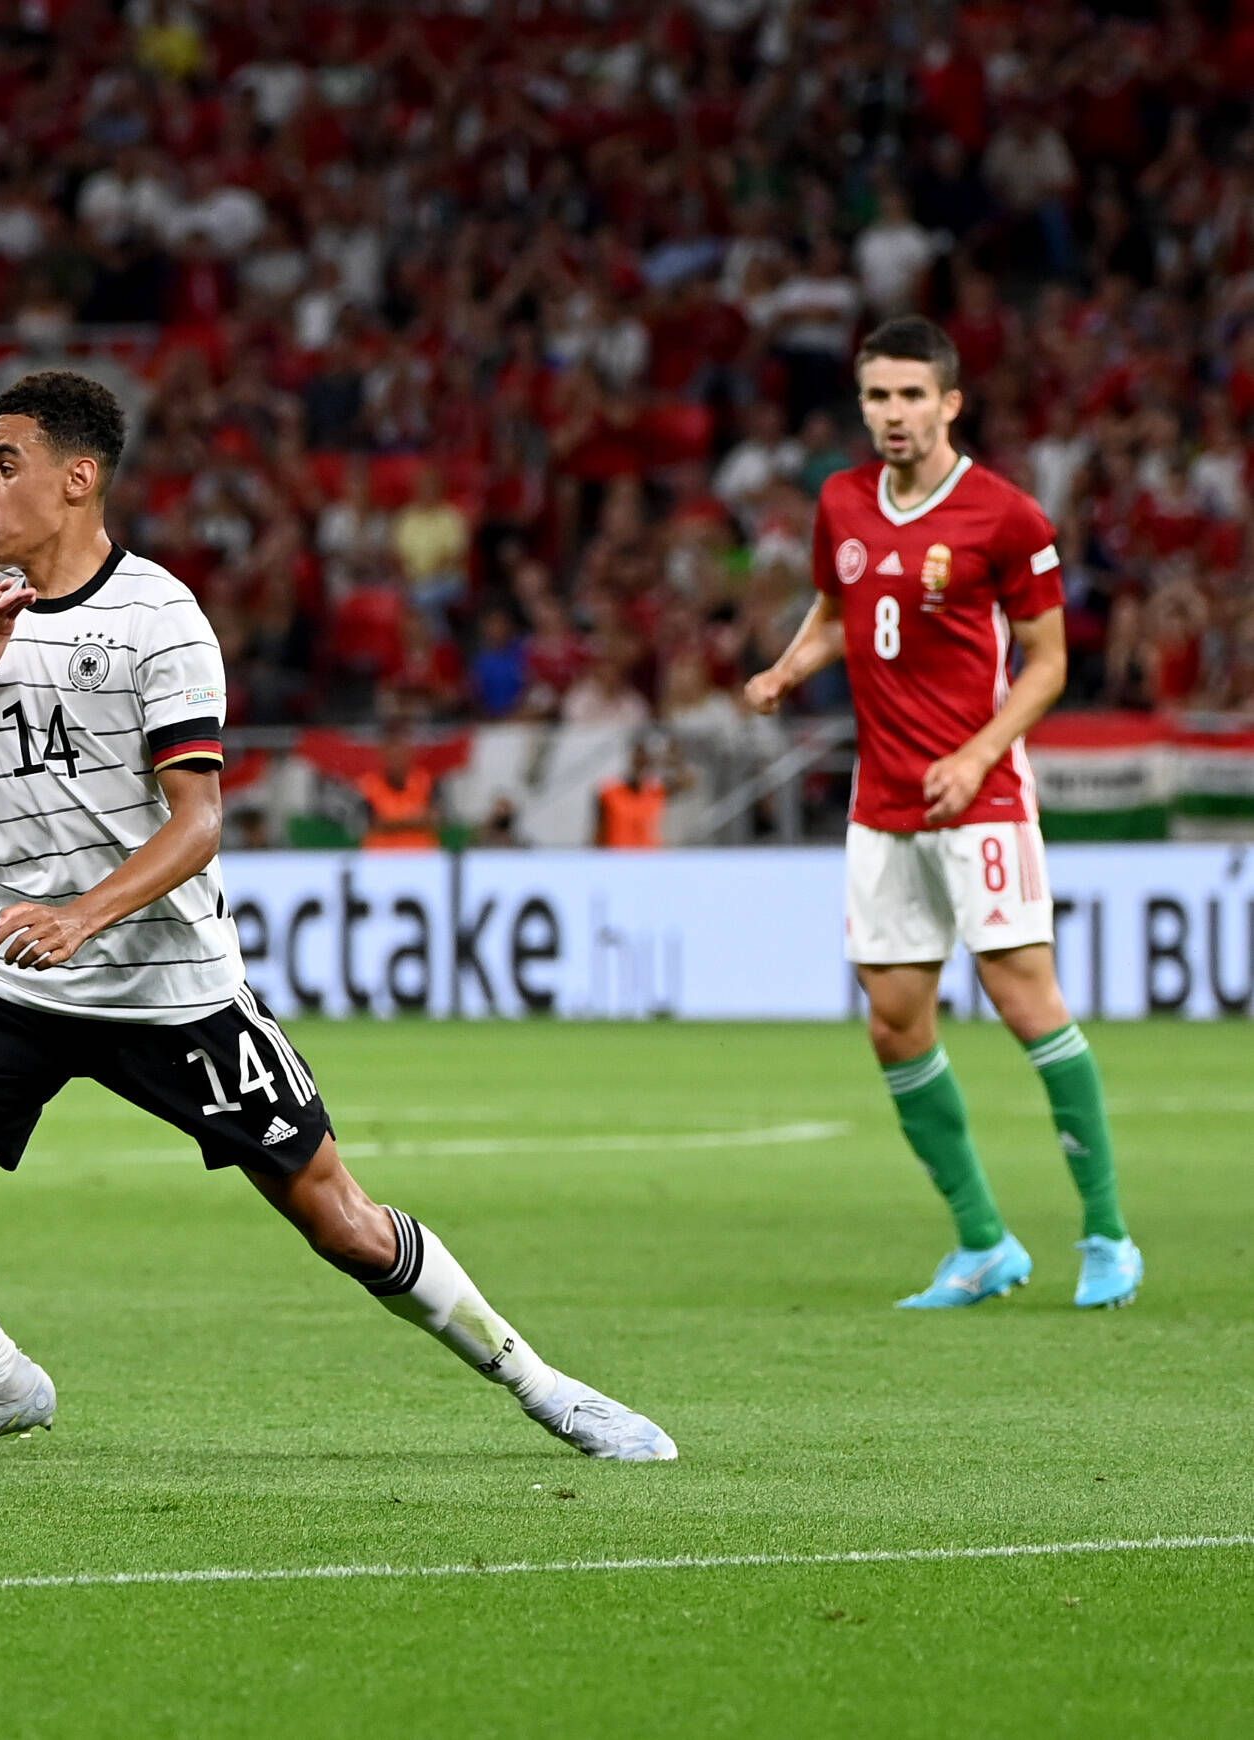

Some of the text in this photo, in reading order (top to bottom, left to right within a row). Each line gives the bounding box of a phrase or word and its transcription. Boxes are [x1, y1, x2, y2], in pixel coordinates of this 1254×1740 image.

[873, 595, 900, 660] 8
[2, 700, 80, 778] 14
[982, 837, 1006, 892] 8
[186, 1030, 279, 1116] 14
[261, 1126, 299, 1146] adidas
